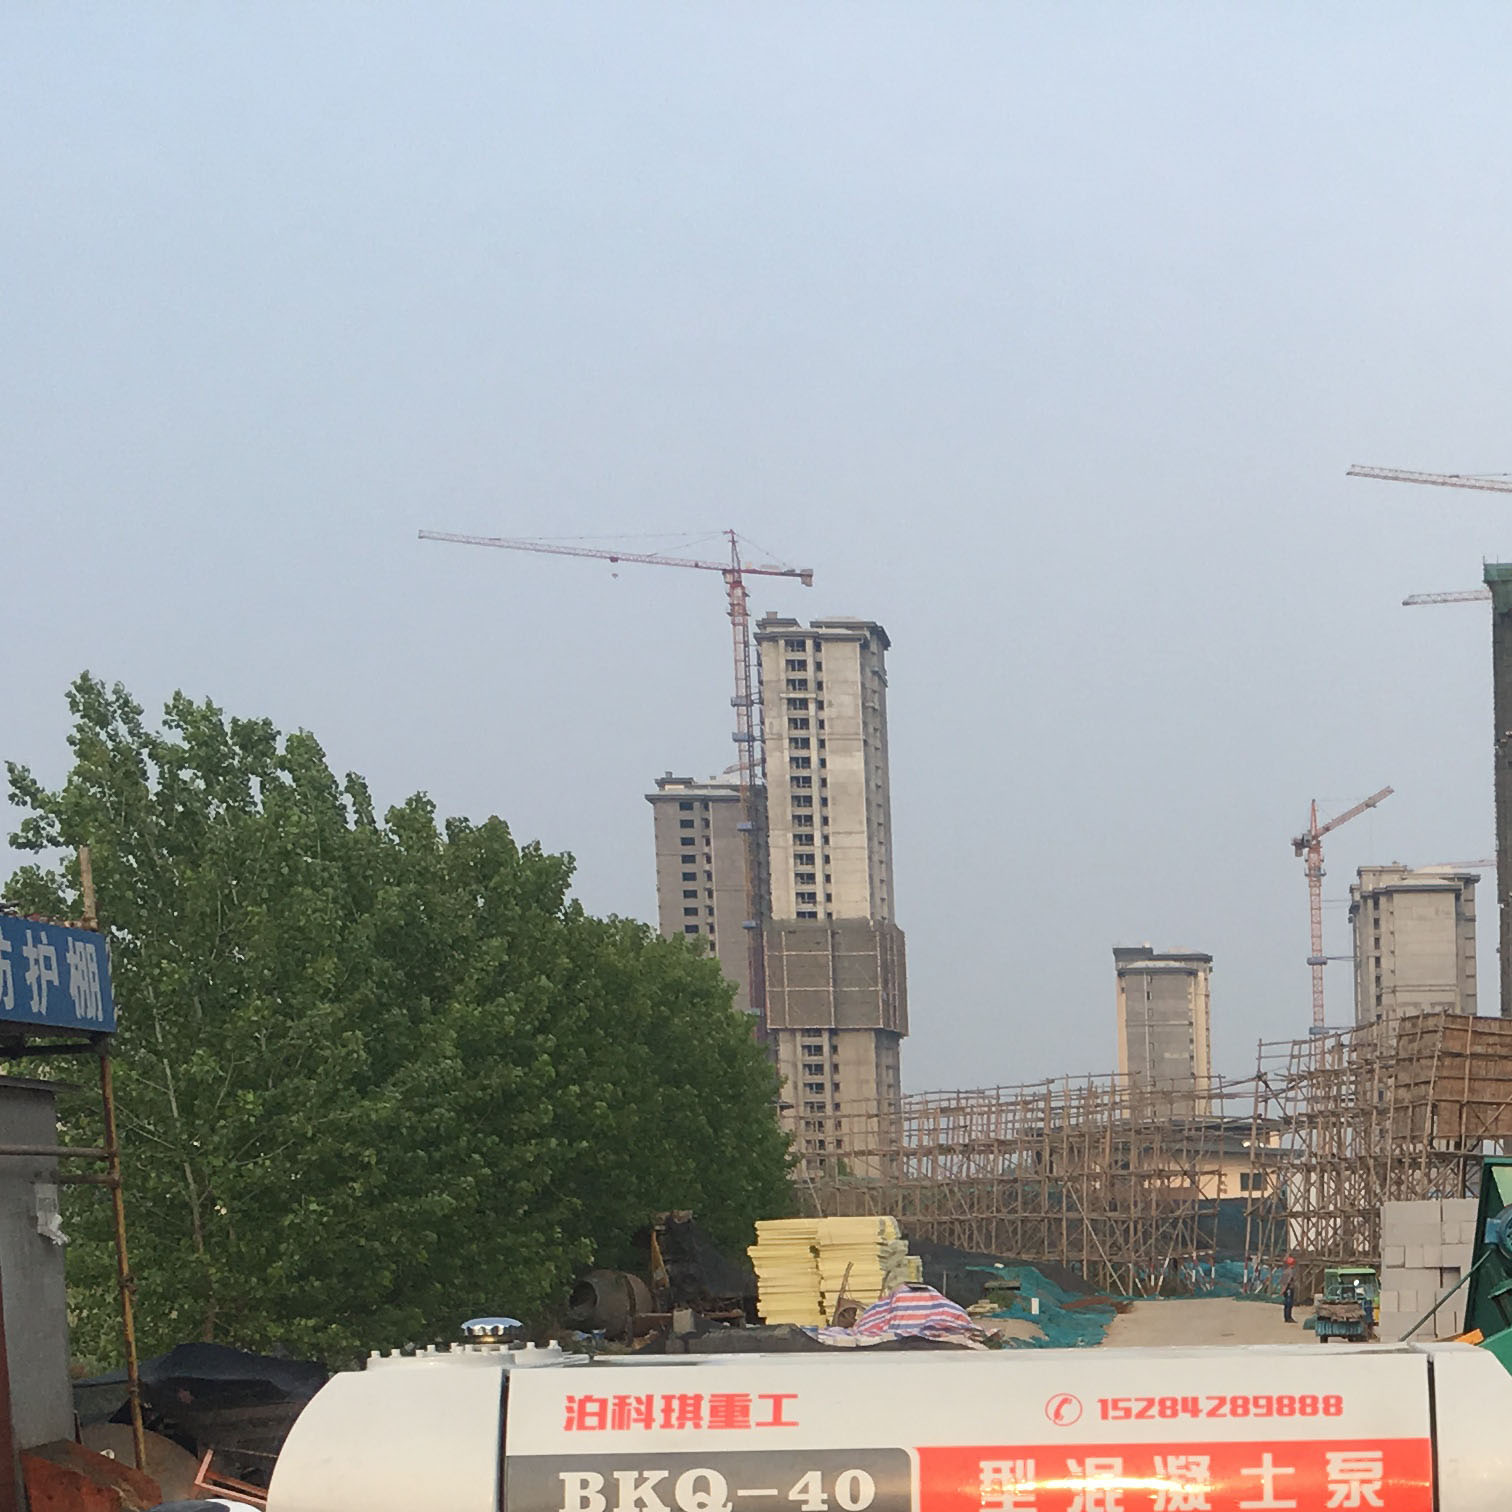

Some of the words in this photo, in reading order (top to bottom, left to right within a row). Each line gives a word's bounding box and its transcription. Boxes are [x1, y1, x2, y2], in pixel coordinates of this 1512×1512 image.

[563, 1393, 799, 1431] 泊科琪重工
[1098, 1394, 1343, 1420] 15284289888
